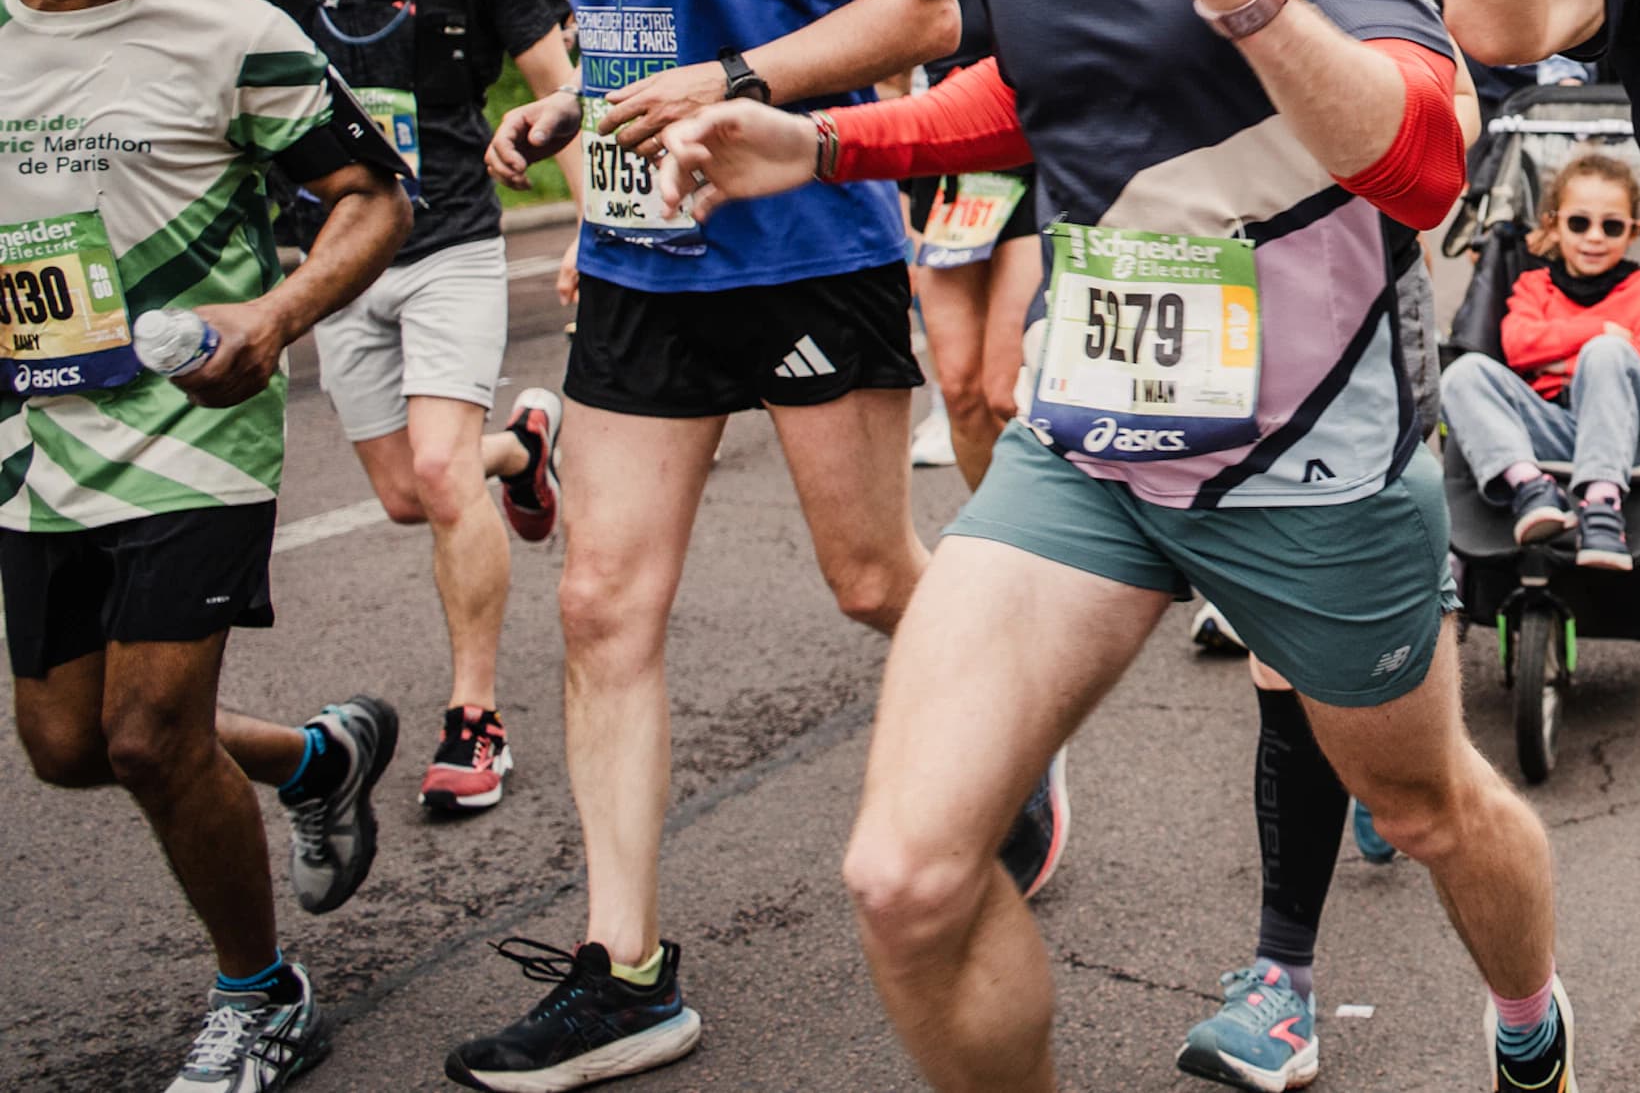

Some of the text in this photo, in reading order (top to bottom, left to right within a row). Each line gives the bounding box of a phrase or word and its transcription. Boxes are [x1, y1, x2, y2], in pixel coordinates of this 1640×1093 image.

[623, 13, 676, 30] ELECTRIC
[623, 31, 638, 52] DE
[640, 31, 678, 52] PARIS
[44, 132, 152, 154] Marathon
[18, 155, 110, 174] de Paris
[10, 239, 79, 260] Electric
[1088, 229, 1222, 263] Schneider
[1138, 261, 1222, 279] Electric
[1085, 287, 1184, 367] 5279
